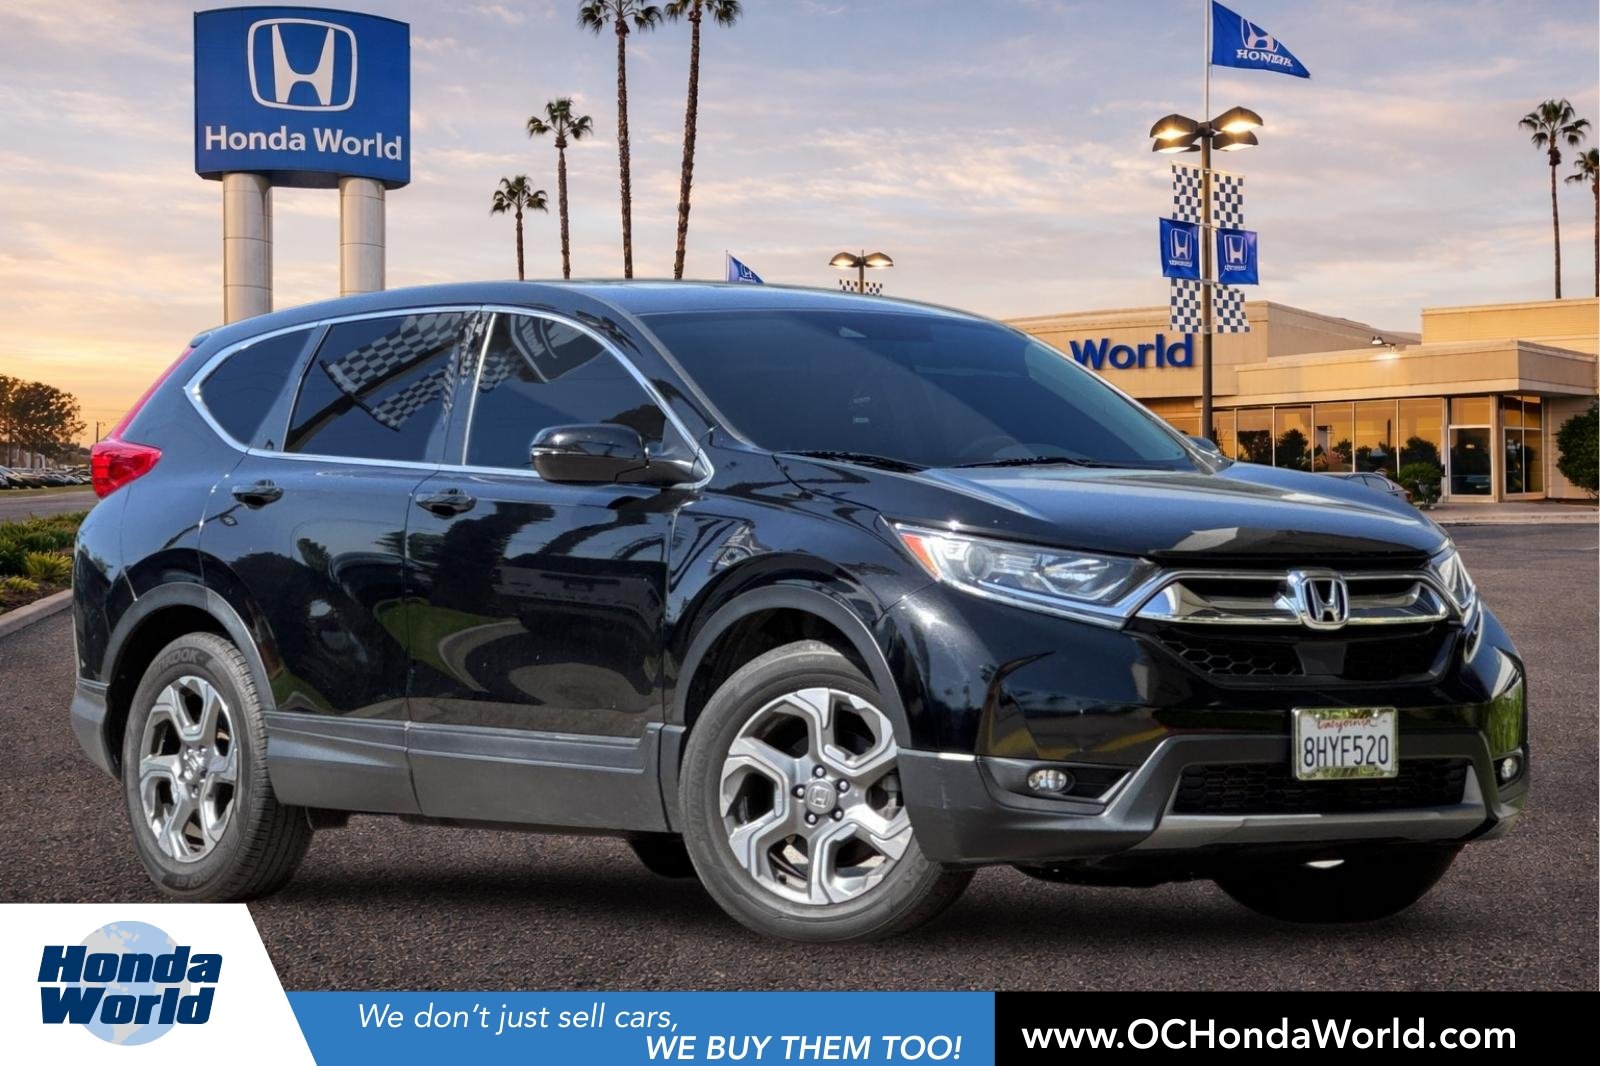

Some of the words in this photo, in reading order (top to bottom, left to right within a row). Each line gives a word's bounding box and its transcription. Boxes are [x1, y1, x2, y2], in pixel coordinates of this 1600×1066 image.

[205, 125, 306, 151] Honda
[313, 127, 402, 161] World
[1069, 333, 1194, 370] World
[1304, 735, 1389, 767] 8HYF520
